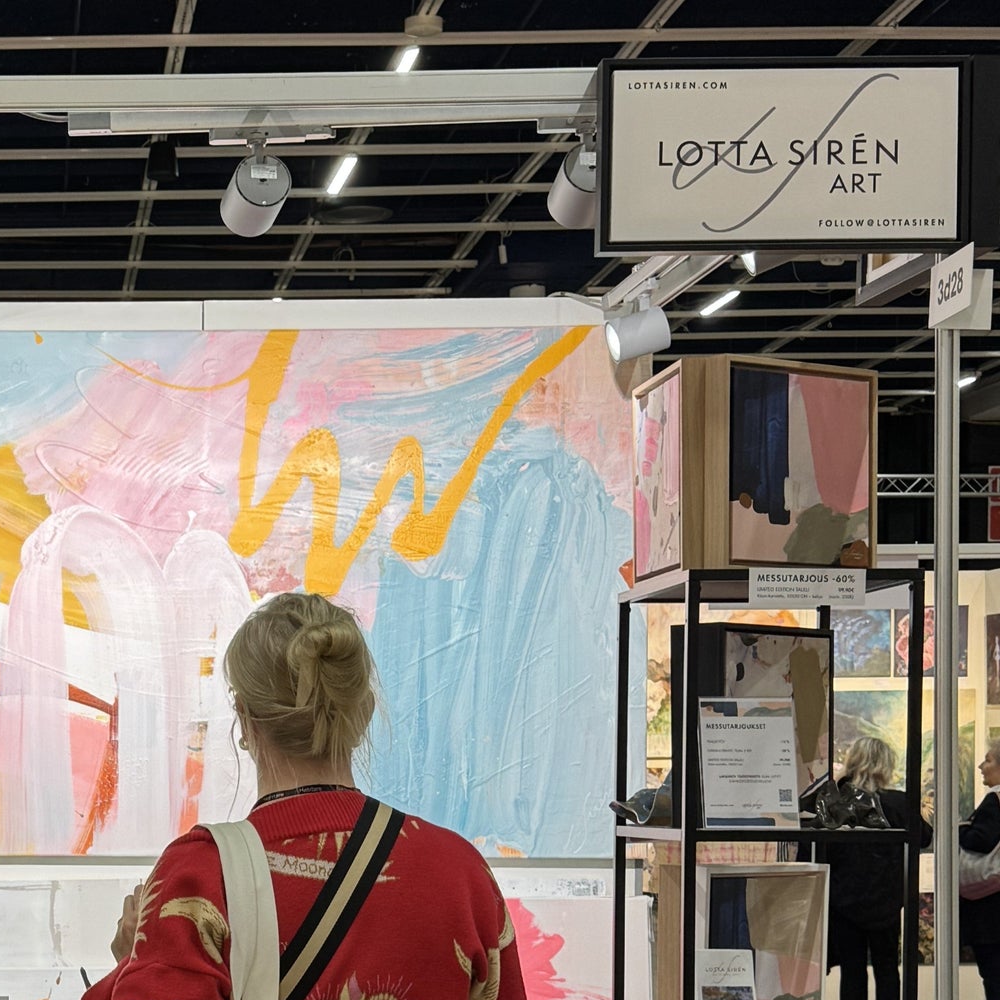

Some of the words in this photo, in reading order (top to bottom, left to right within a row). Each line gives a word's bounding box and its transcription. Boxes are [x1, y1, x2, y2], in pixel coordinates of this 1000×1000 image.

[627, 81, 728, 90] LOTTASIREN.COM
[658, 140, 774, 167] LOTTA
[788, 133, 899, 166] SIRÉN
[829, 173, 882, 194] ART
[818, 218, 945, 227] FOLLOW@LOTTASIREN
[937, 266, 964, 306] 3d28
[757, 574, 829, 582] MESSUTARJOUS
[832, 575, 855, 583] -60%
